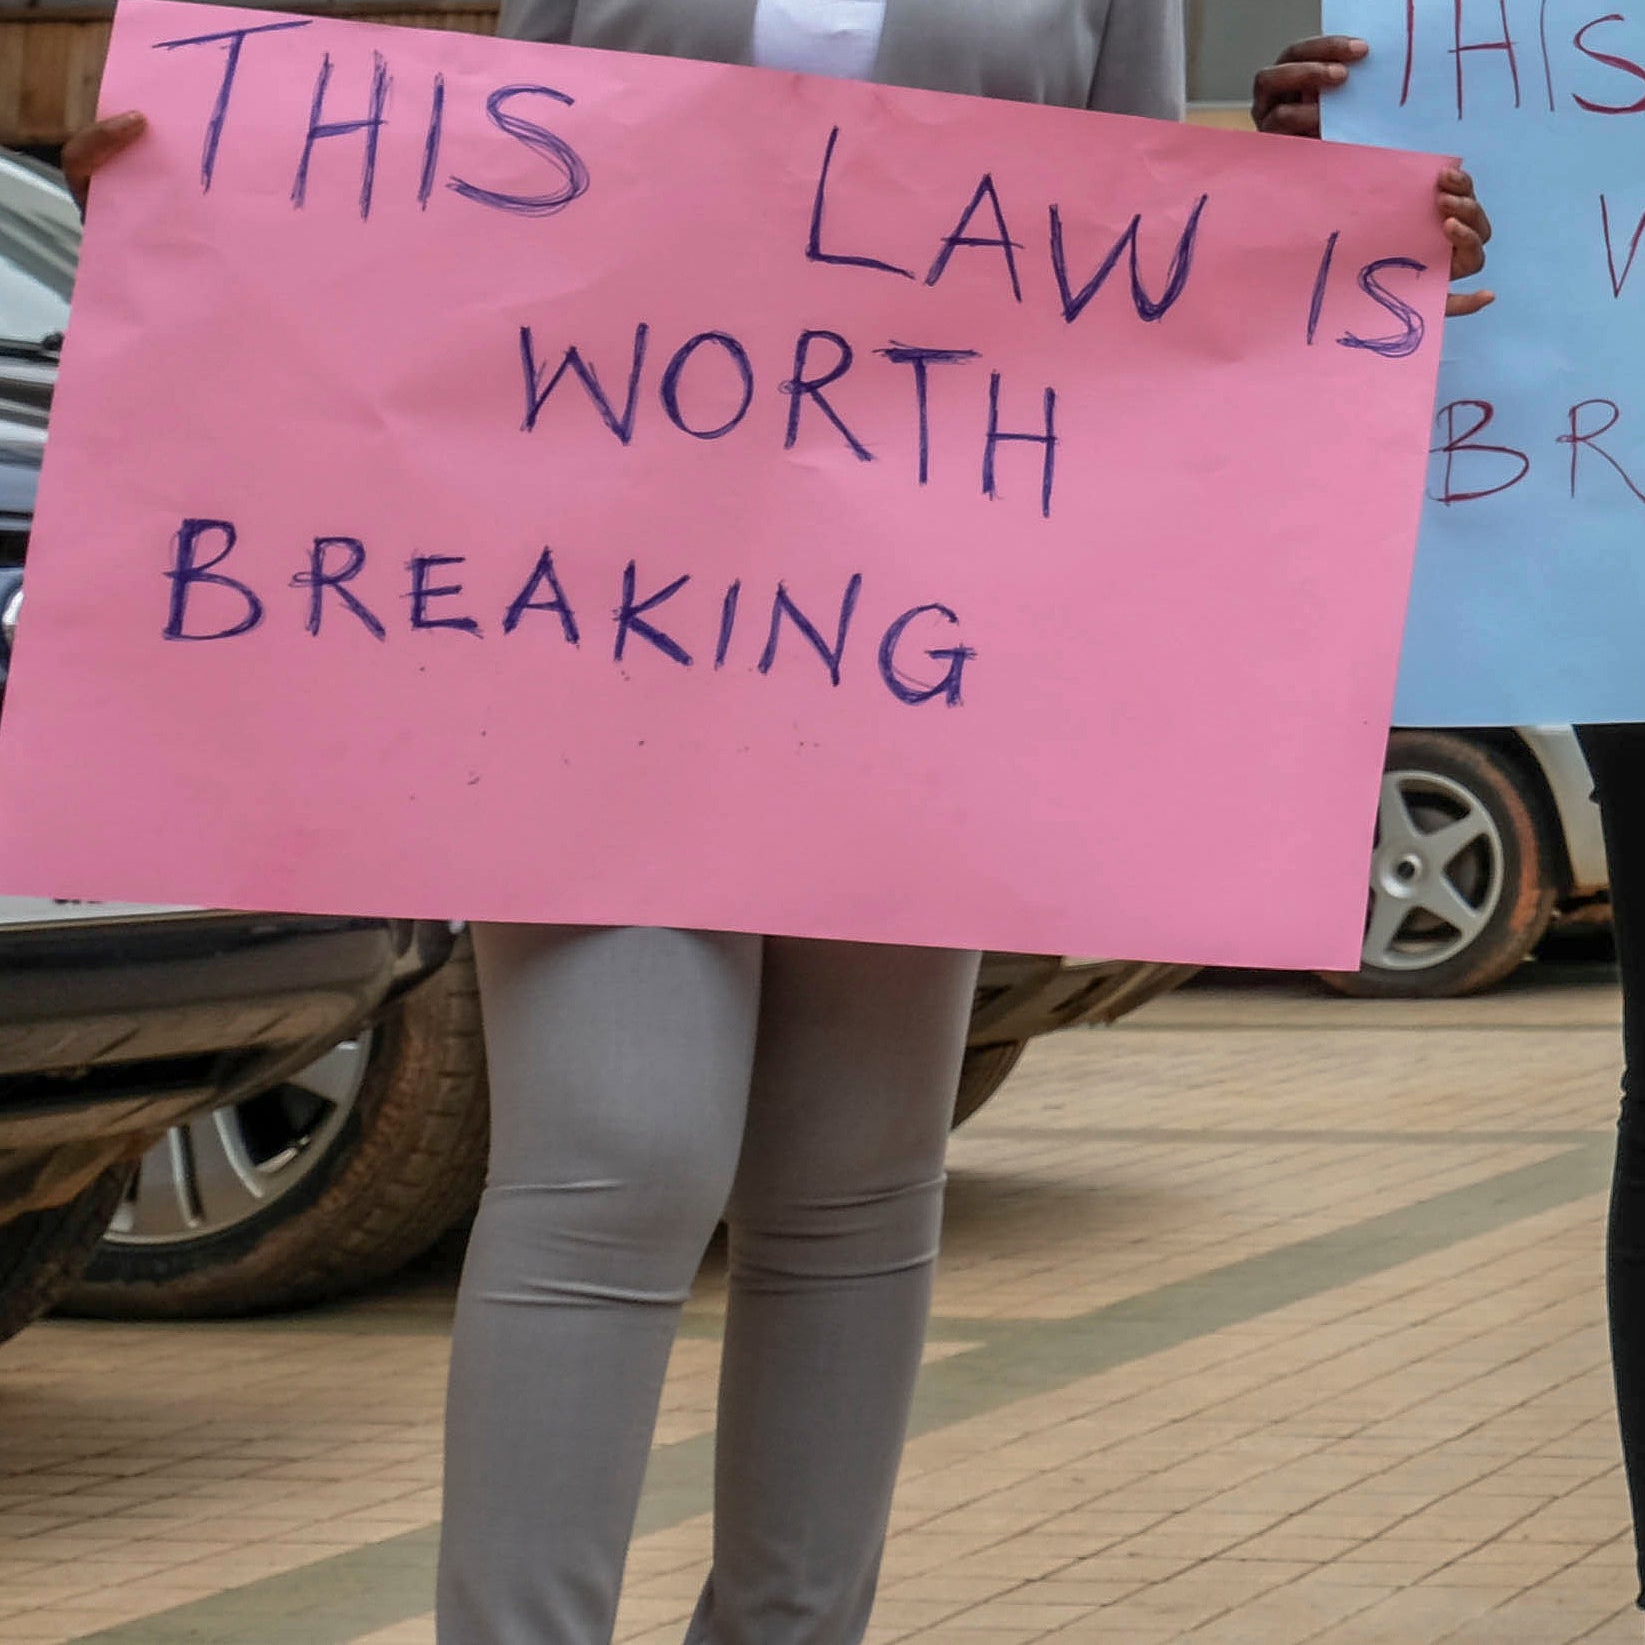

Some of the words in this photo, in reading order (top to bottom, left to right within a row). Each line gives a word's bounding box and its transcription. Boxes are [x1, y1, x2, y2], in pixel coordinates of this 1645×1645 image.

[153, 19, 588, 218] THIS
[805, 125, 1206, 324] LAW
[1307, 231, 1428, 358] IS
[520, 322, 1058, 518] WORTH
[162, 518, 978, 708] BREAKING
